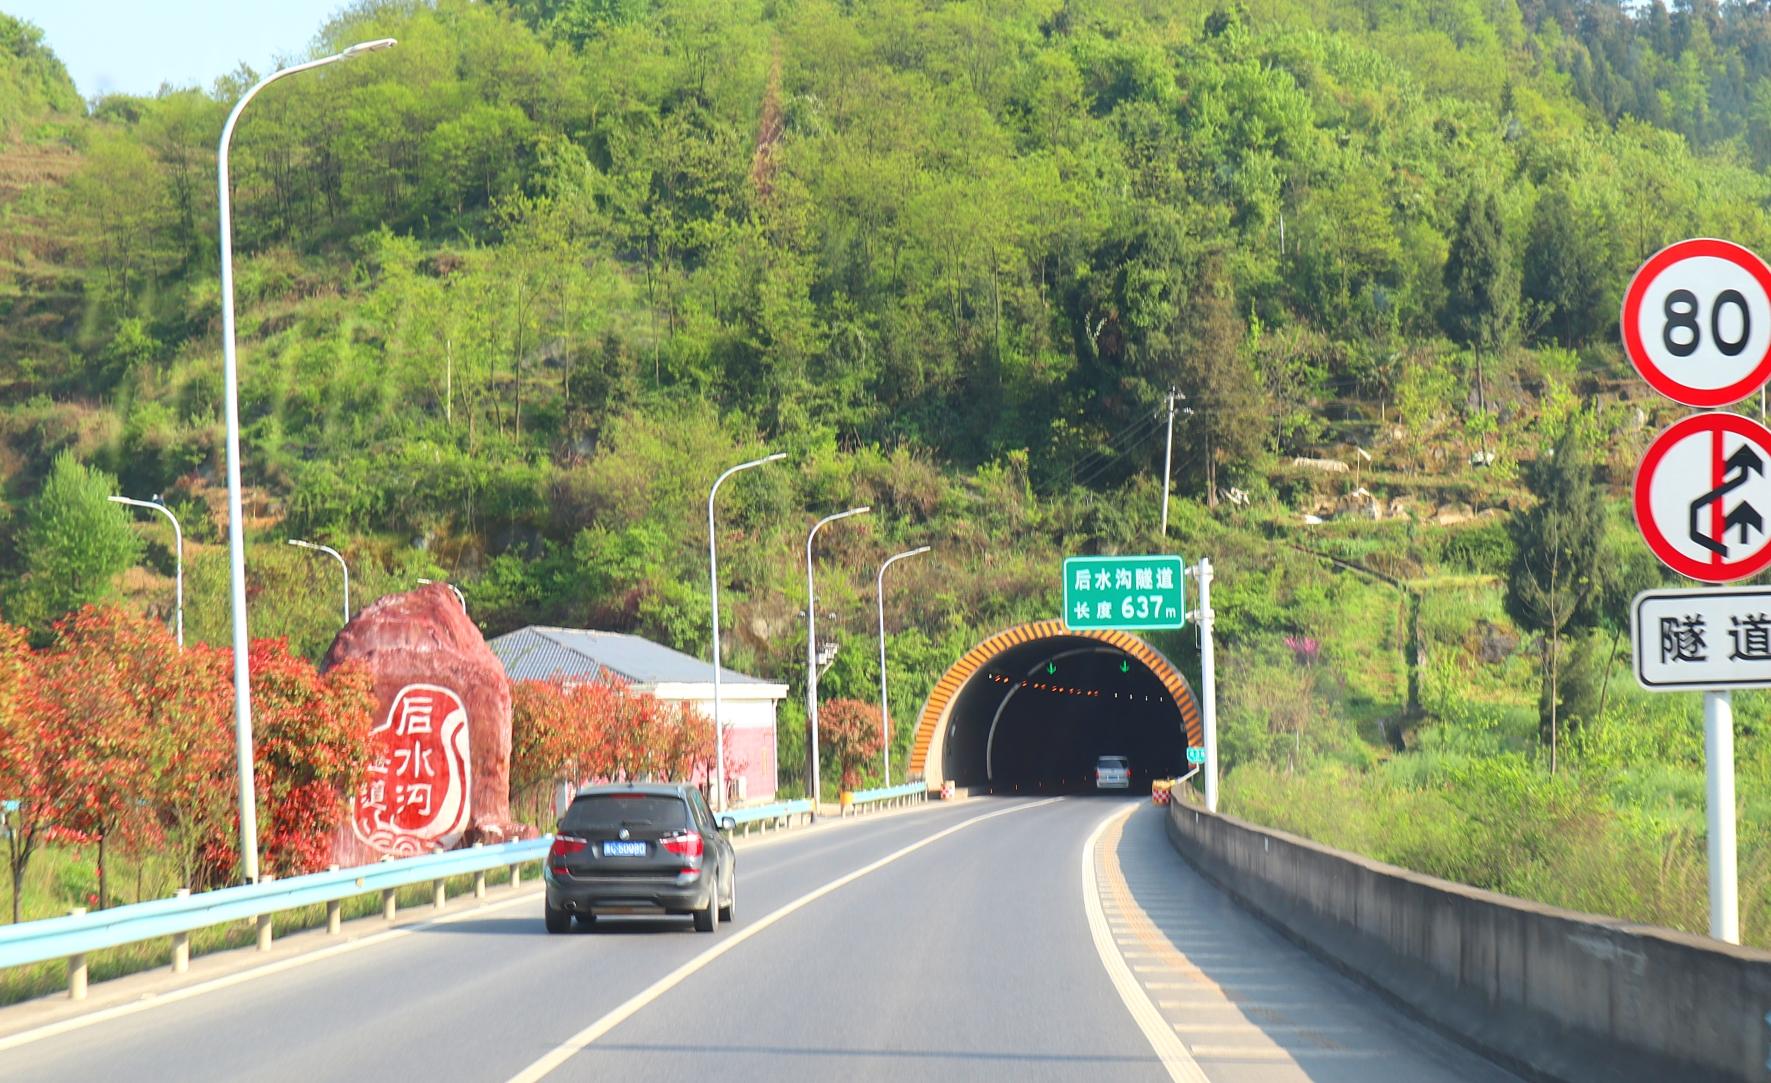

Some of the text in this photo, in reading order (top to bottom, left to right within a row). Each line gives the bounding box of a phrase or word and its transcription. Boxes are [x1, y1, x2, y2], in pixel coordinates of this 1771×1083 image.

[1662, 288, 1751, 357] 80
[1074, 567, 1174, 591] 后水沟隧道
[1073, 594, 1176, 620] 长度 637m
[1658, 613, 1771, 664] 隧道
[394, 695, 435, 817] 后水沟
